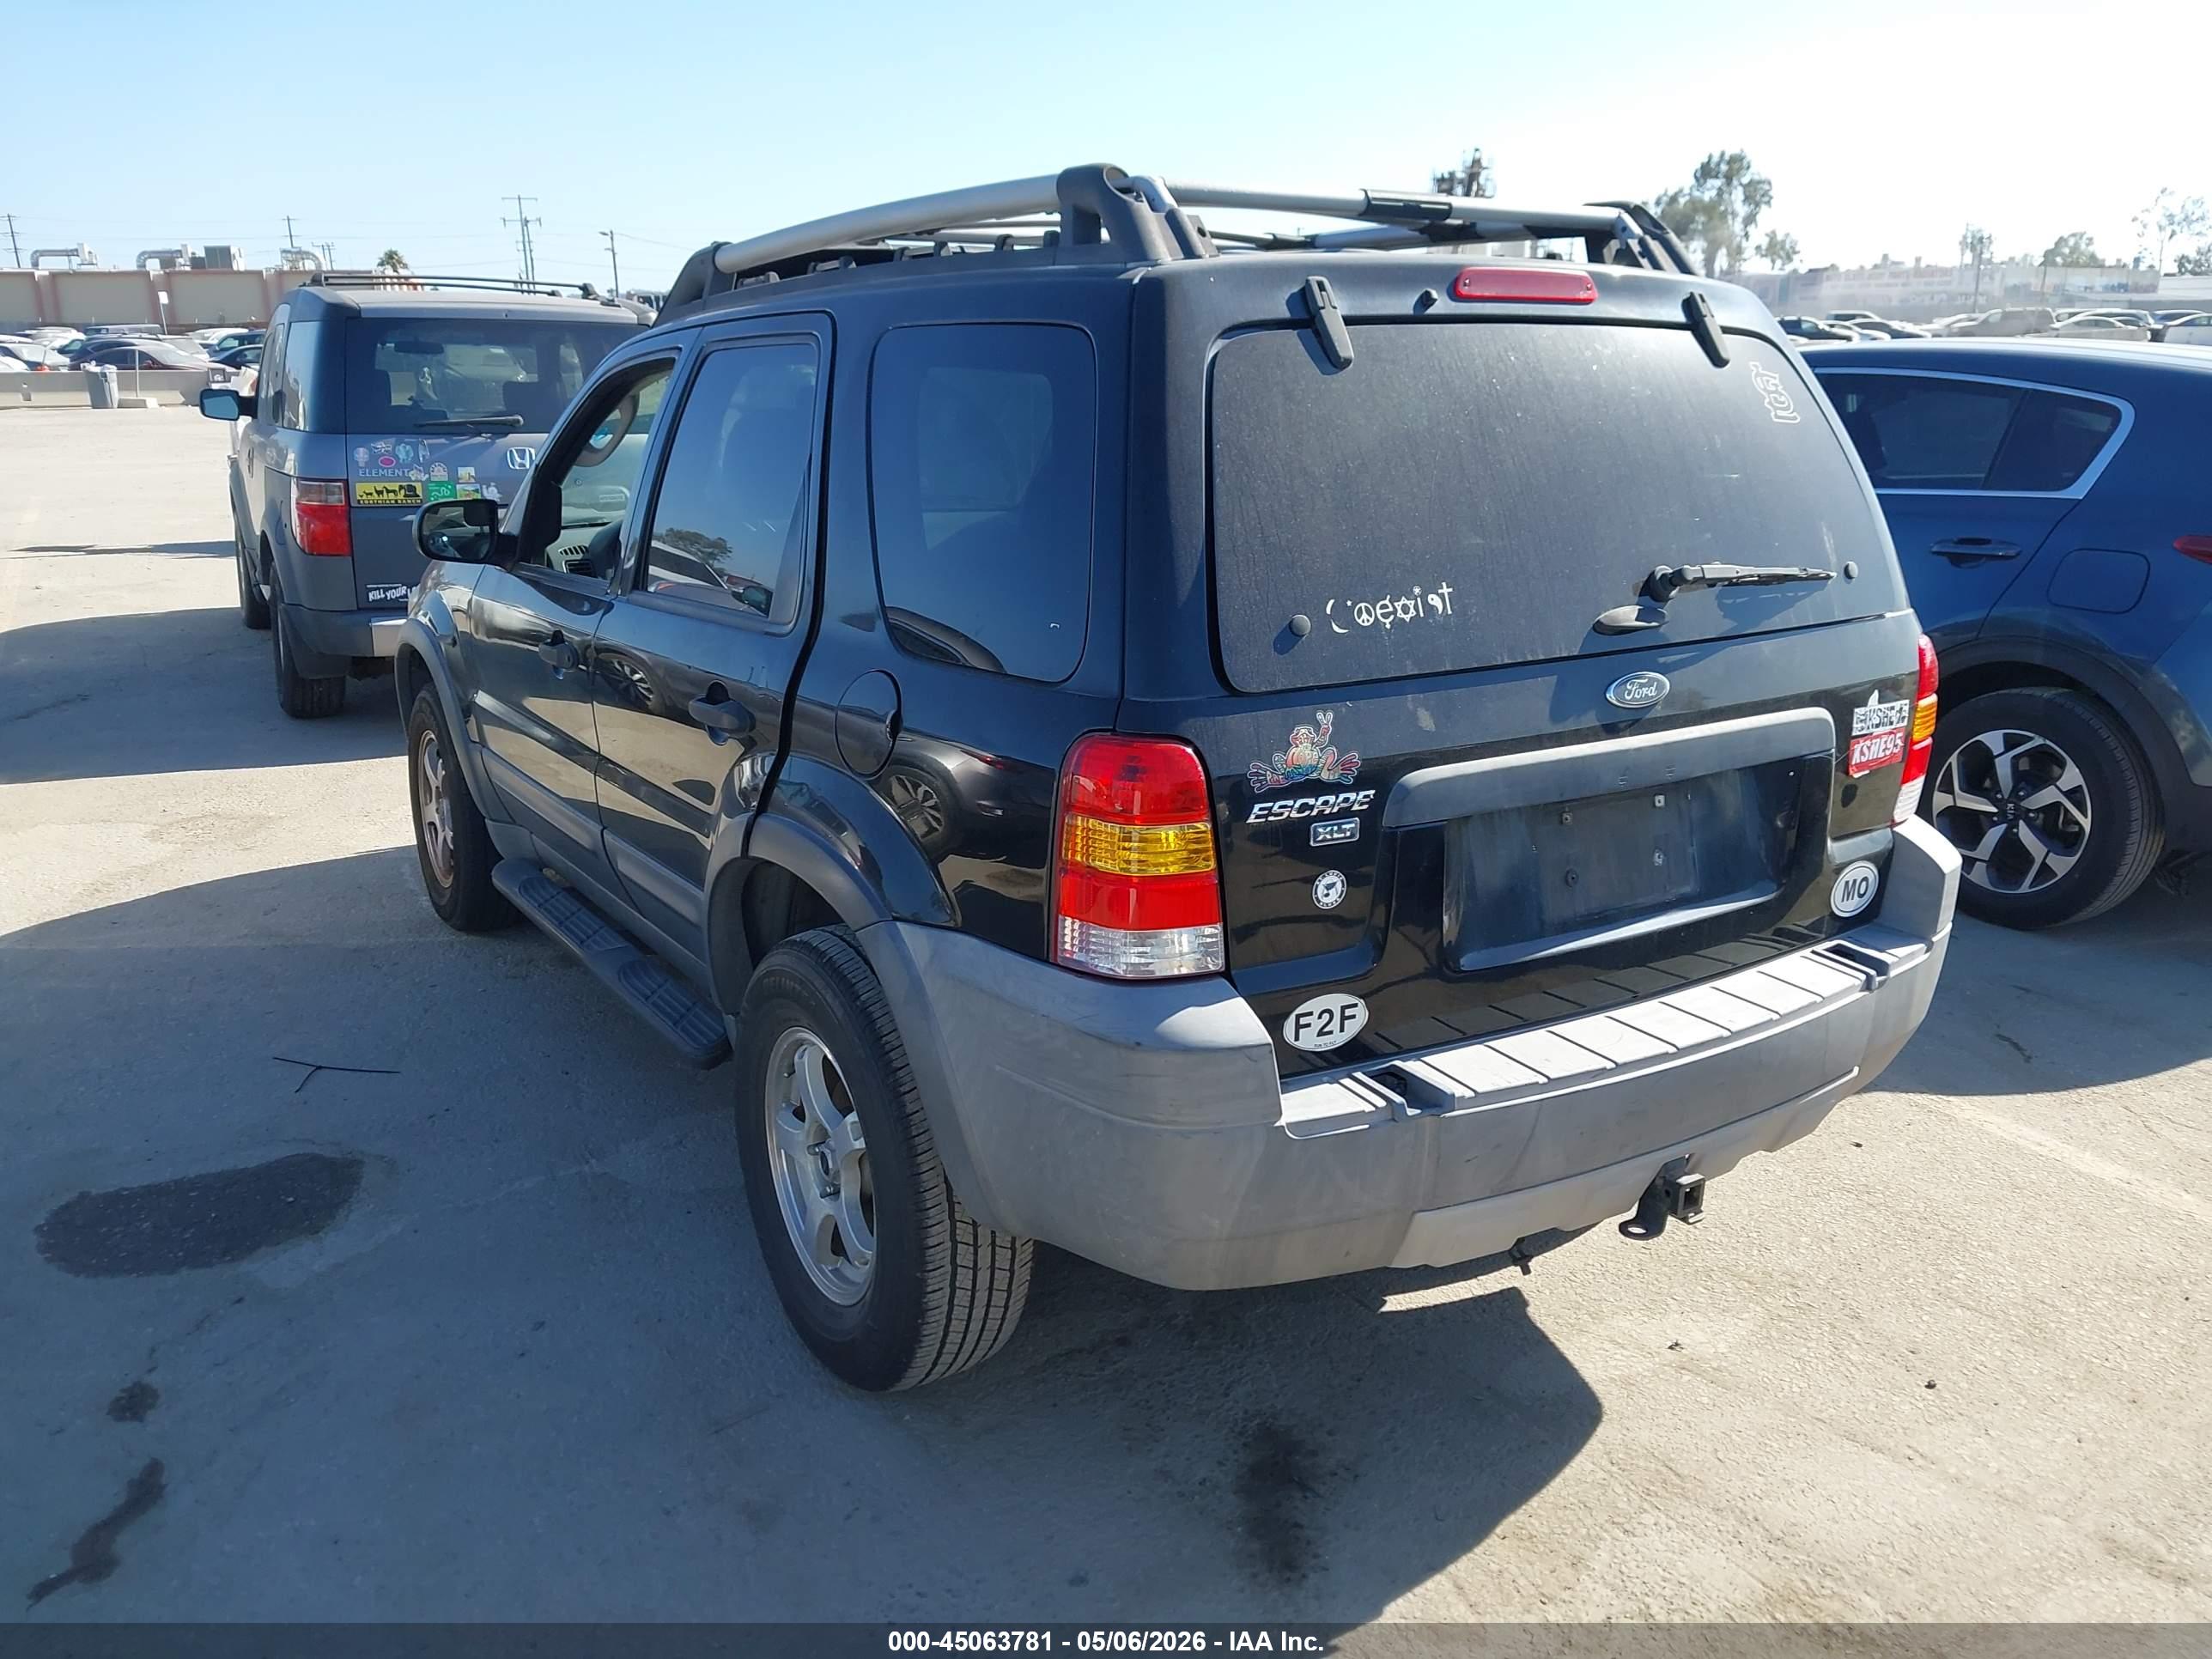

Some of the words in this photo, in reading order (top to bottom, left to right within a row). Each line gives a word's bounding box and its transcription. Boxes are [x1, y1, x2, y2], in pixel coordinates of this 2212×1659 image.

[359, 468, 410, 477] ELEMENT
[368, 589, 385, 602] KILL
[386, 586, 407, 600] YOUR
[1625, 678, 1657, 700] Ford
[1246, 789, 1376, 824] ESCAPE
[1316, 823, 1355, 842] XLT
[1841, 877, 1869, 902] MO
[1294, 1003, 1358, 1042] F2F
